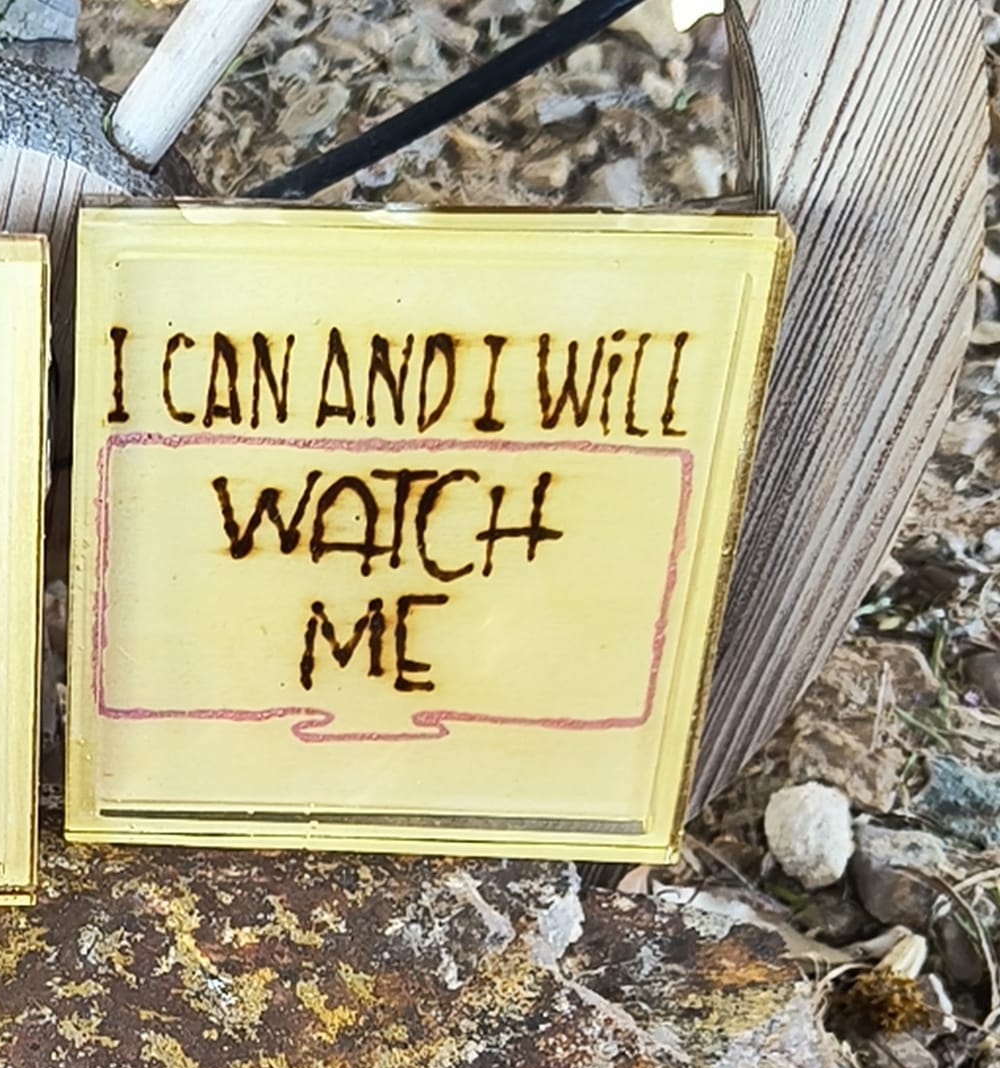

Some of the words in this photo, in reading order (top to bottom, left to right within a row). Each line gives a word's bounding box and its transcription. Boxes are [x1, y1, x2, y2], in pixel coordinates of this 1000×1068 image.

[106, 327, 129, 424] I
[162, 331, 295, 428] CAN
[315, 327, 458, 433] AND
[472, 334, 506, 432] I
[211, 468, 563, 582] WATCH
[299, 593, 449, 691] ME
